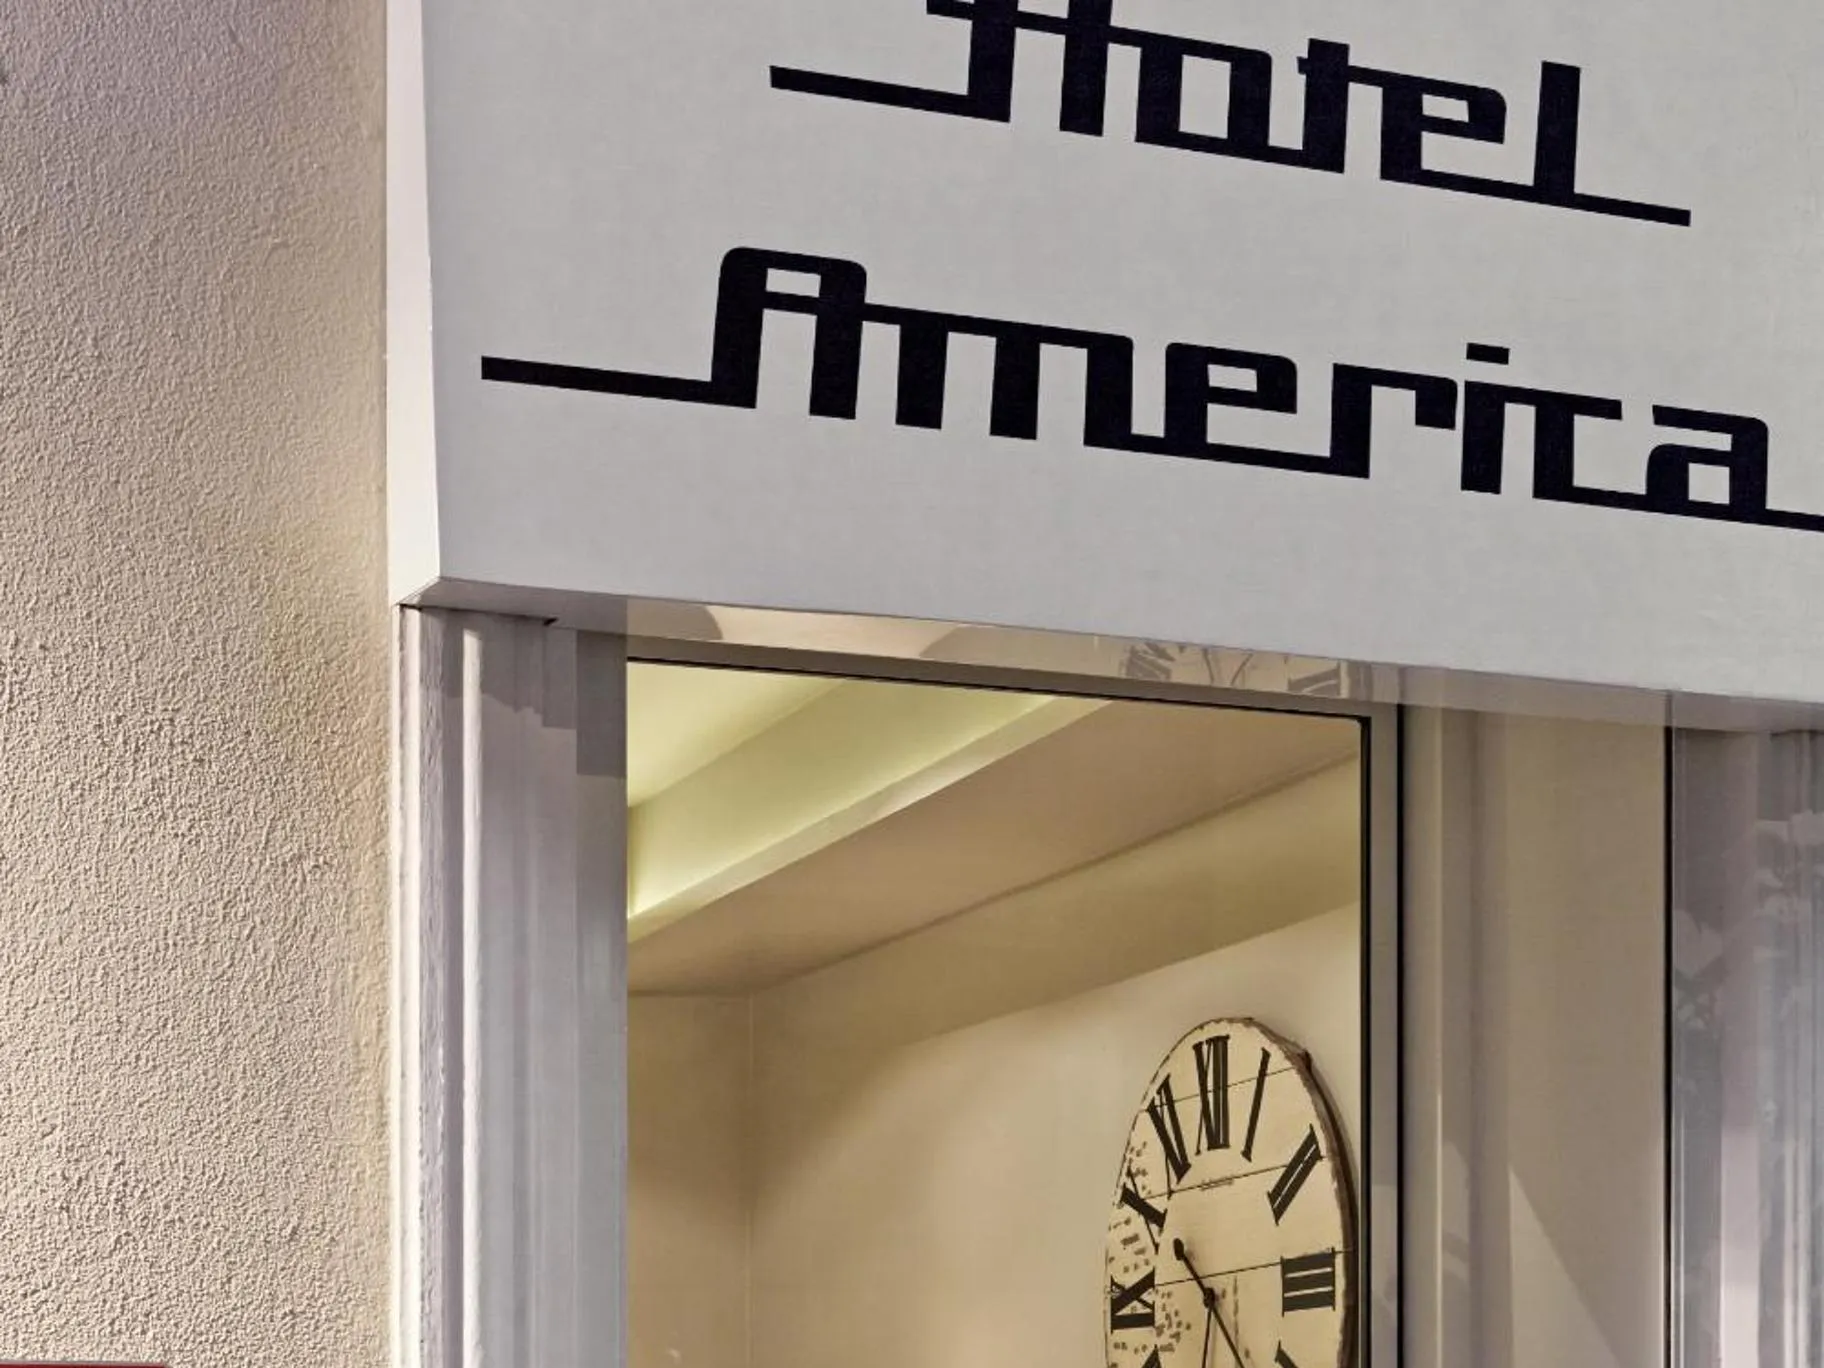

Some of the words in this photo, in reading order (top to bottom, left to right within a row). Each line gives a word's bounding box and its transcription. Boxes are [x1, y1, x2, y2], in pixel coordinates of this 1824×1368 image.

[770, 0, 1691, 227] Hotel
[481, 246, 1824, 531] America
[1192, 1034, 1231, 1157] XII
[1267, 1122, 1323, 1226] II
[1279, 1246, 1337, 1318] III
